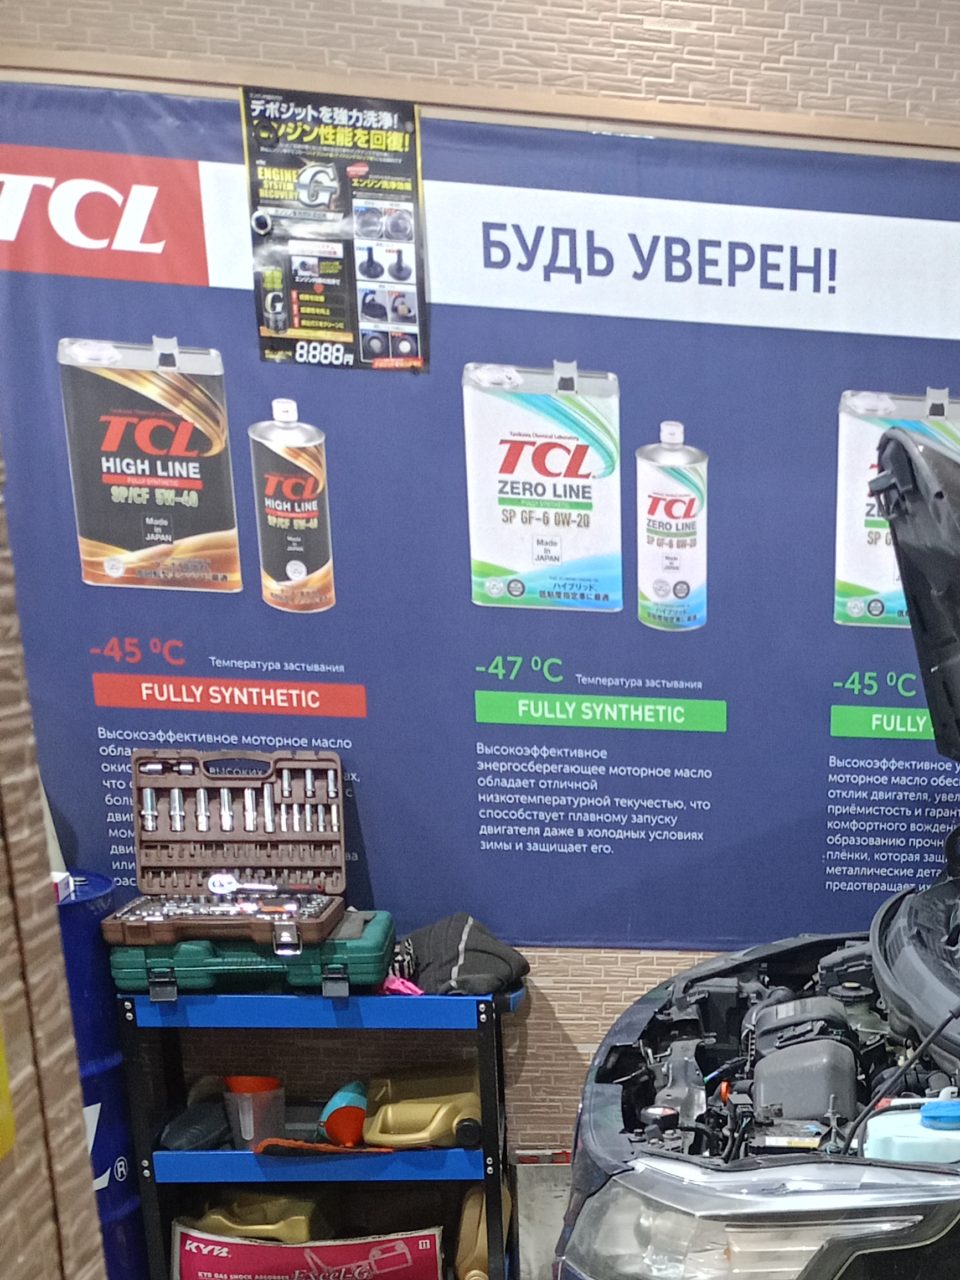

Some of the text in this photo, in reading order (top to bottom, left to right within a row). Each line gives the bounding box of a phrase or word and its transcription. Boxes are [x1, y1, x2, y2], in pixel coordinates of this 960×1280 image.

[257, 167, 299, 182] ENGINE
[0, 172, 166, 255] TCL
[482, 221, 837, 294] БУДЬ УВЕРЕН!
[99, 415, 200, 458] TCL
[498, 439, 593, 479] TCL
[101, 457, 201, 479] HIGH LINE
[264, 472, 319, 500] TCL
[498, 480, 592, 500] ZERO LINE
[265, 497, 318, 512] HIGH LINE
[648, 495, 697, 520] TCL
[145, 517, 168, 527] Made
[502, 509, 590, 528] SP GF-6 0W-20
[646, 518, 696, 531] ZERO LINE
[145, 533, 172, 542] JAPAN
[536, 538, 558, 547] Made
[867, 531, 882, 545] SP
[534, 553, 560, 563] JAPAN
[90, 637, 141, 663] -45
[209, 656, 345, 673] Температура застывания
[475, 656, 523, 681] -47
[575, 673, 703, 689] Температура застывания
[833, 671, 878, 696] -45
[141, 682, 320, 708] FULLY SYNTHETIC
[517, 700, 686, 724] FULLY SYNTHETIC
[871, 713, 927, 732] FULLY
[97, 727, 352, 749] Высокоэффективное моторное масло
[476, 742, 608, 760] Высокоэффективное
[477, 761, 713, 779] энергосберегающее моторное масло
[828, 756, 952, 772] Высокоэффективное
[102, 780, 126, 789] что
[477, 776, 598, 791] обладает отличной
[828, 774, 888, 786] моторное
[891, 776, 928, 786] масло
[478, 792, 711, 811] низкотемпературной текучестью, что
[827, 789, 868, 800] отклик
[871, 790, 931, 802] двигателя,
[478, 809, 678, 827] способствует плавному запуску
[827, 804, 912, 817] приёмистость
[914, 807, 922, 816] и
[479, 825, 704, 842] двигателя даже в холодных условиях
[827, 820, 907, 833] комфортного
[480, 841, 614, 856] зимы и защищает его.
[826, 834, 906, 847] образованию
[826, 850, 920, 863] плёнки, которая
[826, 865, 914, 877] металлические
[825, 880, 916, 892] предотвращает
[184, 1239, 231, 1258] KYB
